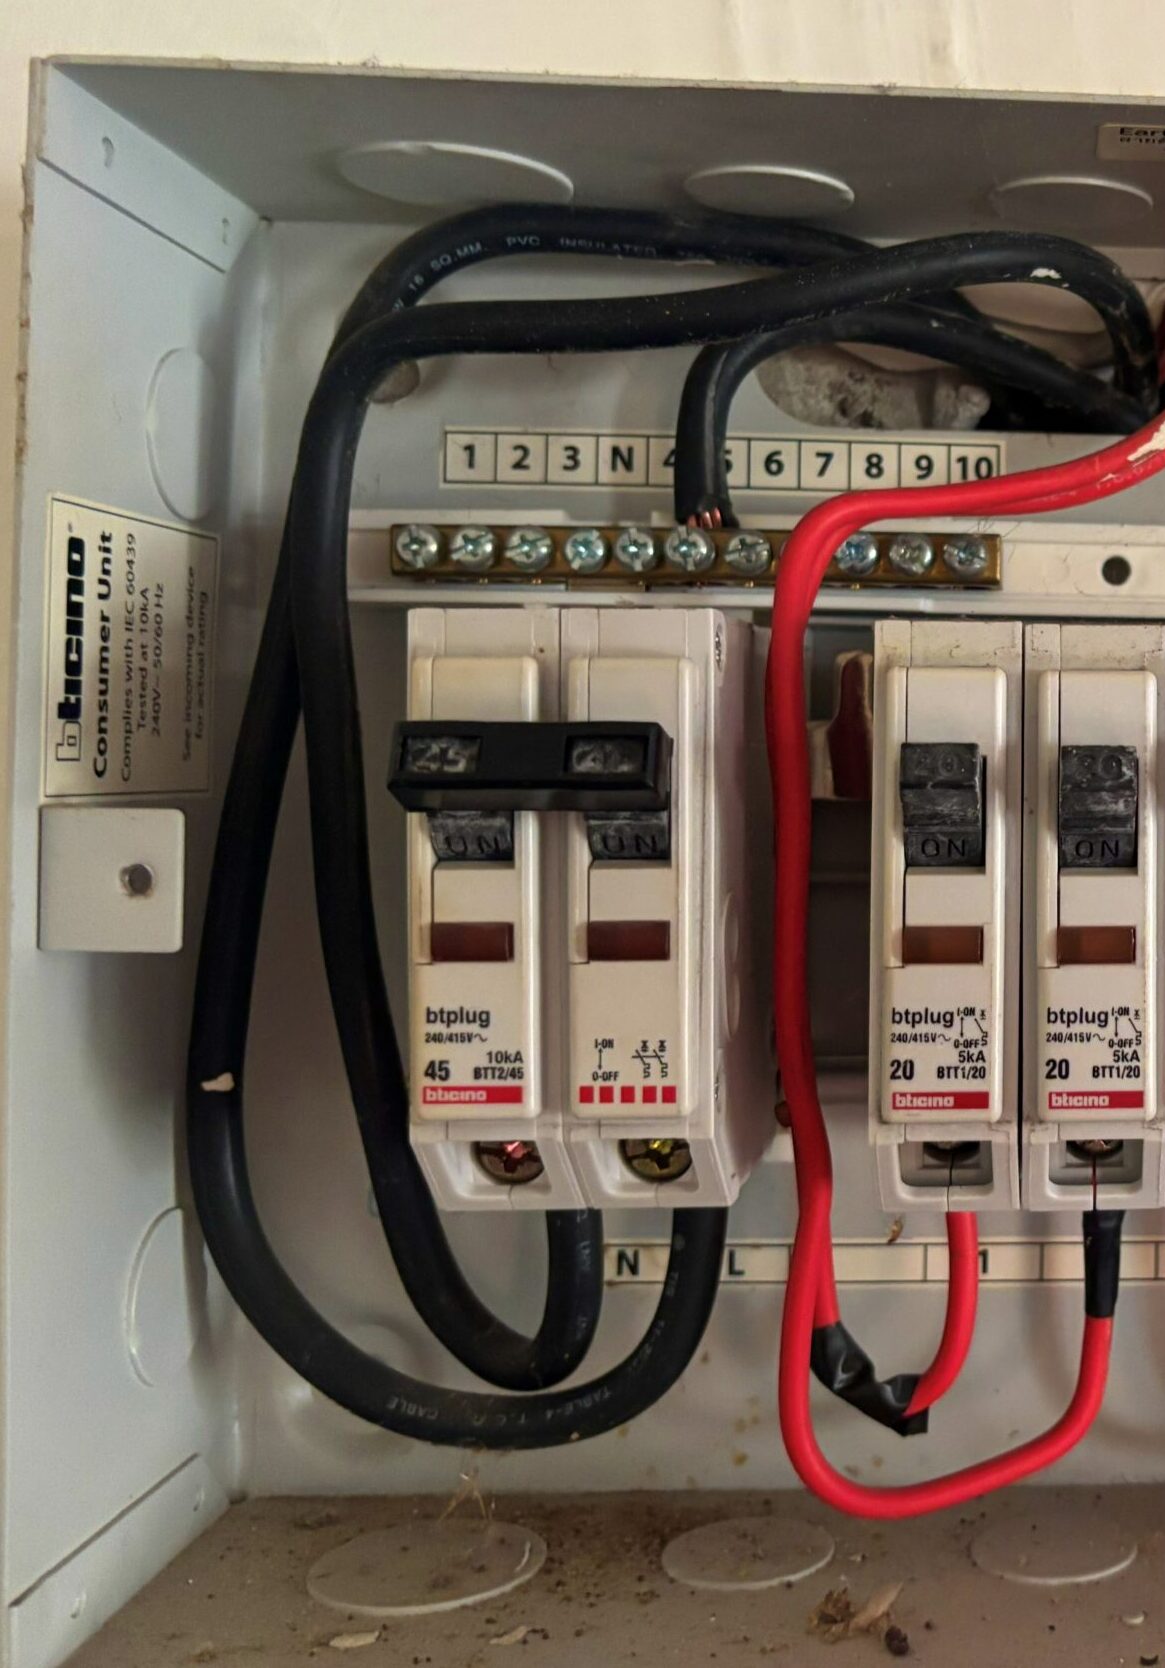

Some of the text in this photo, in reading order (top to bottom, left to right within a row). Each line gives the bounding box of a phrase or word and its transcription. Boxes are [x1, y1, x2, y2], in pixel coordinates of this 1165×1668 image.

[505, 235, 541, 247] PVC
[463, 444, 475, 469] 1
[511, 444, 531, 471] 2
[562, 445, 581, 472] 3
[610, 446, 634, 473] N
[764, 450, 785, 477] 6
[815, 451, 834, 478] 7
[864, 453, 884, 479] 8
[914, 454, 934, 480] 9
[956, 456, 994, 480] 10
[154, 583, 164, 608] Hz
[56, 536, 85, 761] bticino
[153, 613, 164, 668] 50/60
[93, 530, 112, 778] Consumer Unit
[121, 533, 137, 782] Complies with IEC 60439
[137, 587, 150, 731] Tested at 10kA
[183, 566, 196, 762] See incoming device
[195, 591, 208, 739] for actual rating
[920, 838, 967, 858] ON
[1075, 838, 1121, 859] ON
[425, 1006, 490, 1028] btplug
[891, 1007, 954, 1029] btplug
[1047, 1007, 1109, 1029] btplug
[486, 1051, 523, 1064] 10kA
[958, 1050, 986, 1063] 5kA
[1112, 1050, 1141, 1063] 5kA
[424, 1060, 524, 1081] 45 BTT2/45
[890, 1059, 987, 1080] 20 BTT1/20
[1045, 1058, 1141, 1080] 20 BTT1/20
[895, 1094, 954, 1107] bticino
[1051, 1093, 1109, 1107] bticino
[616, 1250, 640, 1275] N
[728, 1250, 745, 1275] L
[978, 1249, 989, 1274] 1
